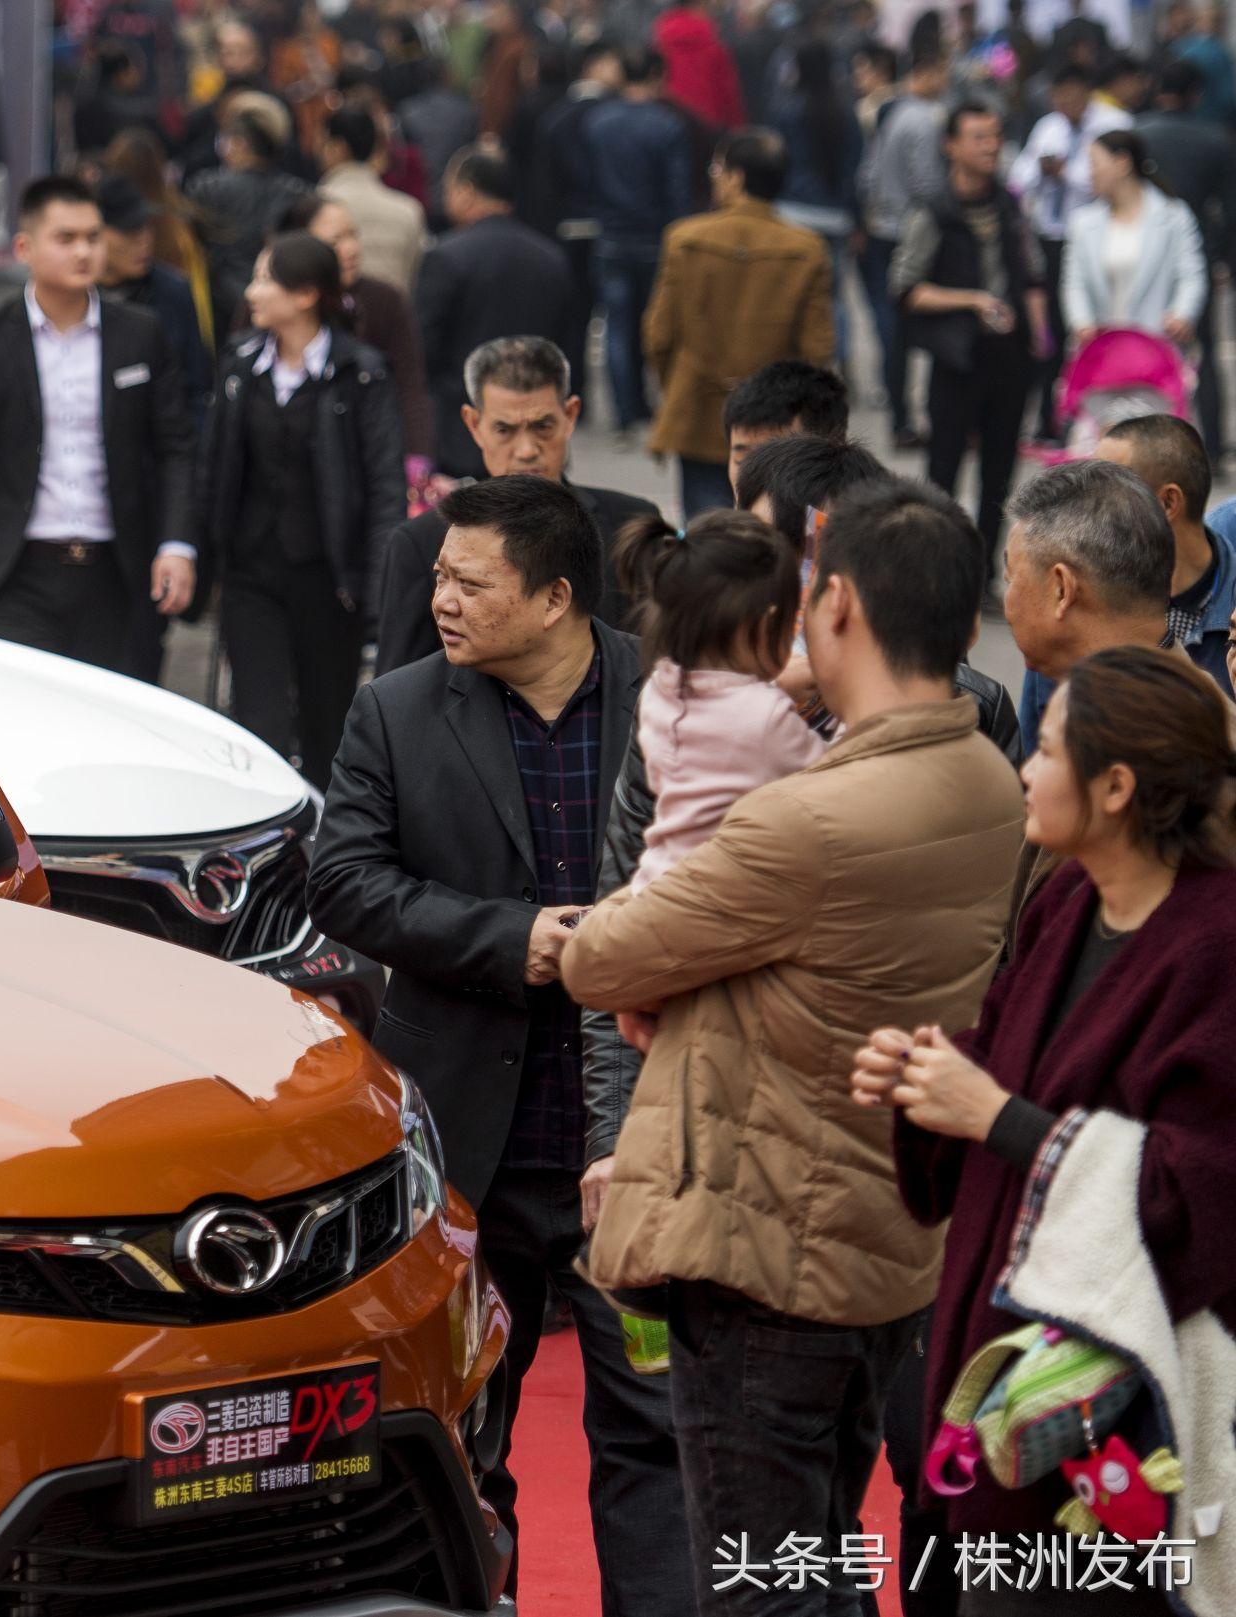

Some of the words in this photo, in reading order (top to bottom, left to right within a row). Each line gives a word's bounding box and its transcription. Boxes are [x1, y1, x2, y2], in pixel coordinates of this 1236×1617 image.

[207, 1391, 290, 1434] 三菱合资制造
[291, 1375, 376, 1462] DX3
[206, 1426, 290, 1466] 非自主国产
[154, 1472, 253, 1509] 株洲东南三菱4S店
[315, 1455, 370, 1480] 28415668
